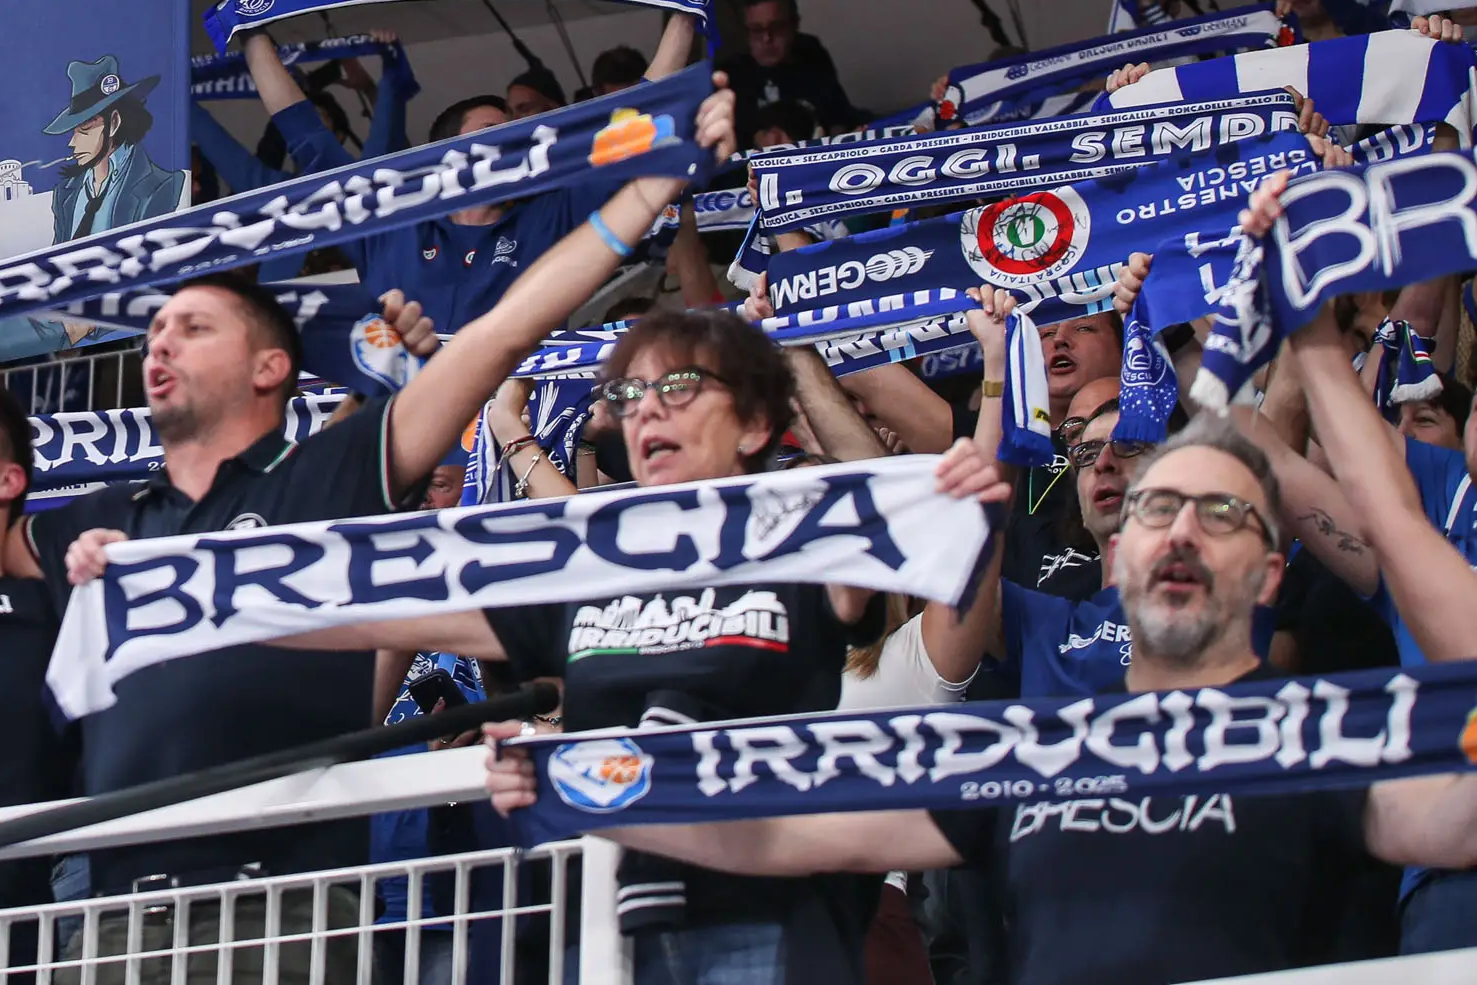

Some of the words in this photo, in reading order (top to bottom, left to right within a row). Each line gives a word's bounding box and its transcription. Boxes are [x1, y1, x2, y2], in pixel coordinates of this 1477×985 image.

[880, 143, 912, 153] GARDA
[916, 136, 960, 148] PRESENTE
[971, 127, 1032, 141] IRRIDUCIBILI
[1035, 119, 1089, 133] VALSABBIA
[828, 142, 1040, 196] OGGI.
[884, 193, 918, 203] GARDA
[921, 186, 965, 199] PRESENTE
[976, 178, 1037, 192] IRRIDUCIBILI
[1038, 170, 1093, 184] VALSABBIA
[990, 269, 1031, 284] ITALIA
[103, 473, 908, 663] BRESCIA
[568, 611, 790, 654] IRRIDUCIBILI
[690, 674, 1421, 797] IRRIDUCIBILI
[961, 779, 1034, 800] 2010
